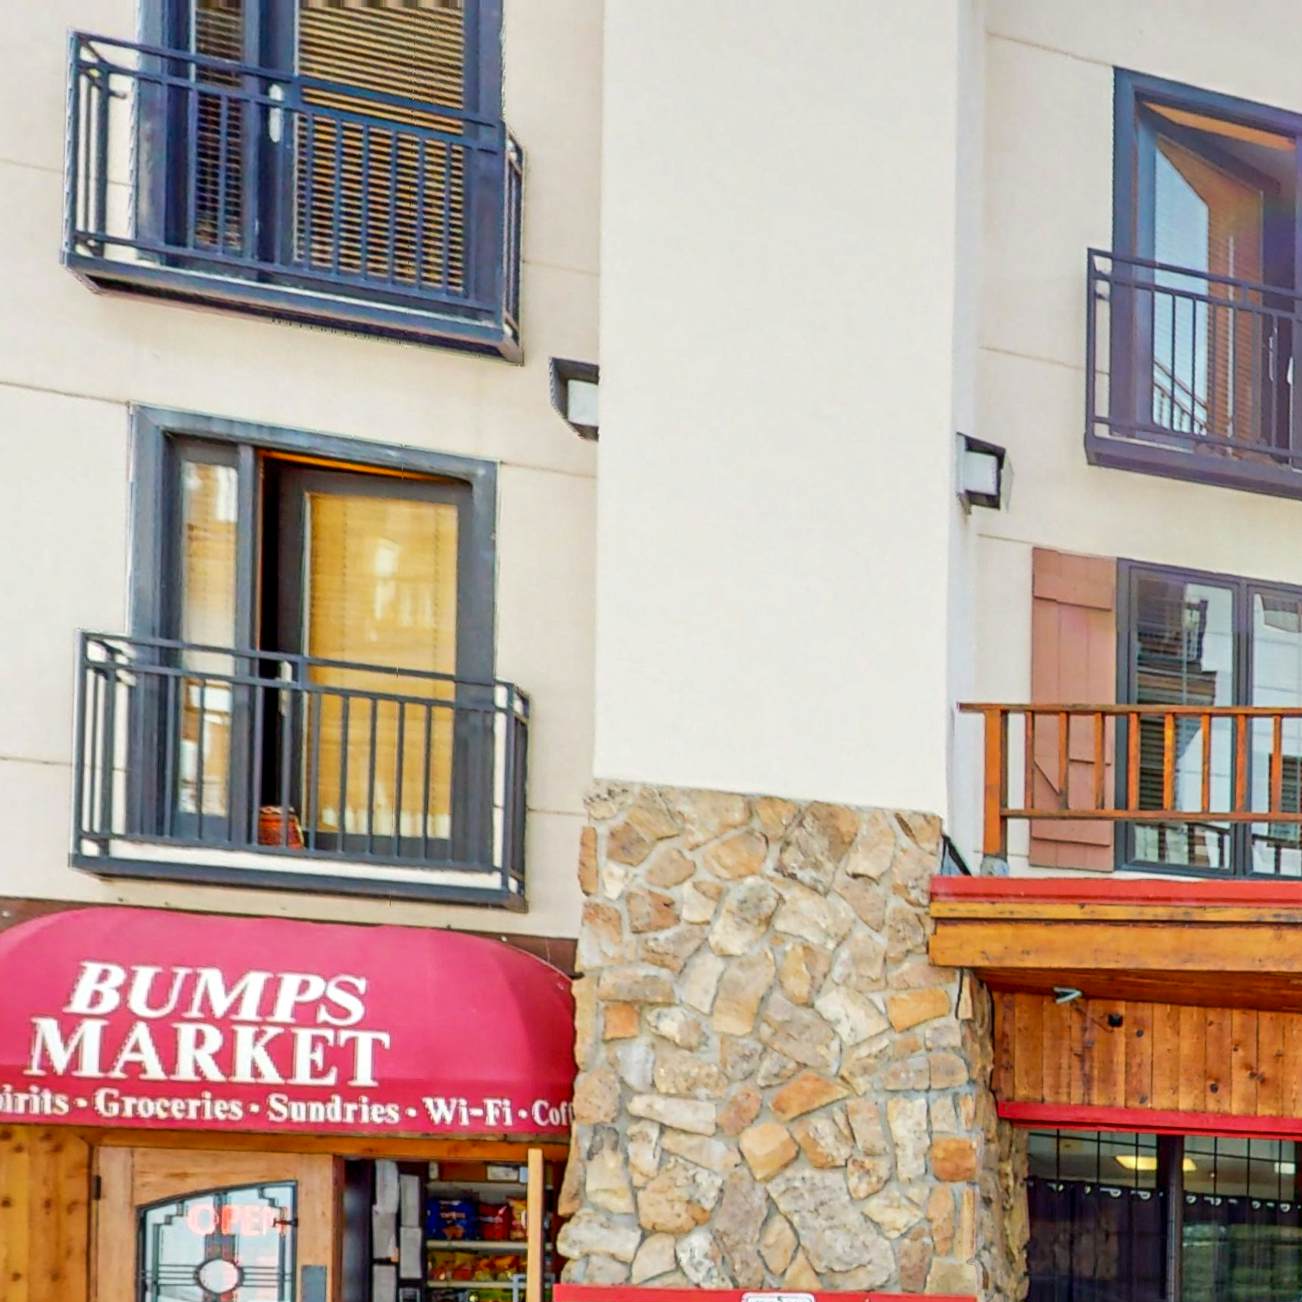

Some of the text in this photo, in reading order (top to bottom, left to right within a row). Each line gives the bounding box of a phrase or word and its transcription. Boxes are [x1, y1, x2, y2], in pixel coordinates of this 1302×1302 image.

[62, 960, 367, 1027] BUMPS
[23, 1017, 391, 1088] MARKET
[0, 1083, 70, 1116] irits
[95, 1087, 244, 1122] Groceries
[266, 1092, 400, 1124] Sundries
[421, 1096, 513, 1127] Wi-Fi
[186, 1203, 287, 1237] OPEN
